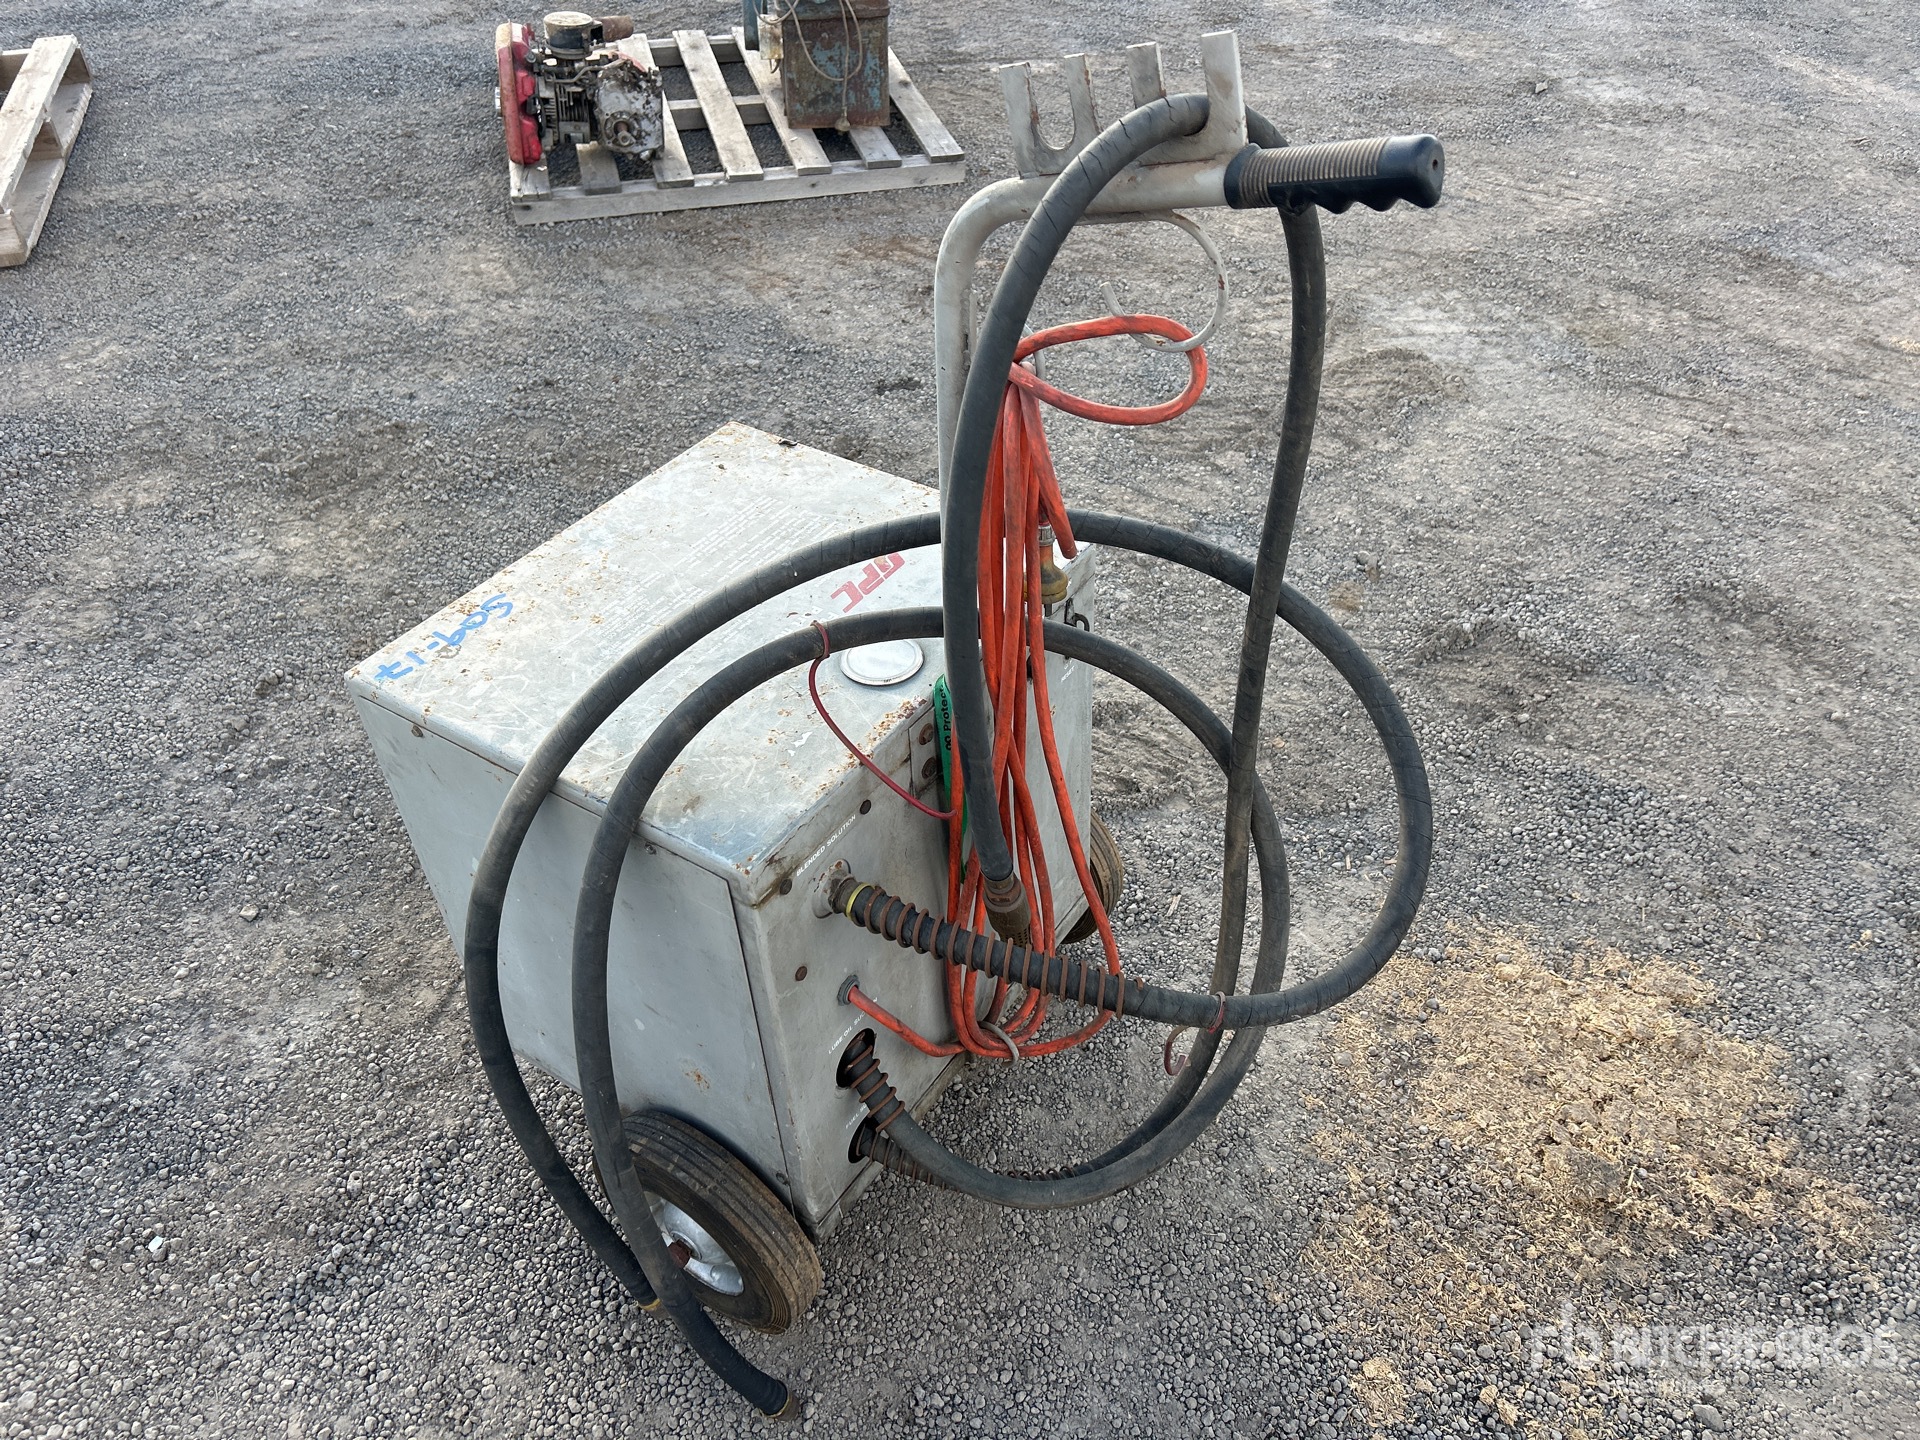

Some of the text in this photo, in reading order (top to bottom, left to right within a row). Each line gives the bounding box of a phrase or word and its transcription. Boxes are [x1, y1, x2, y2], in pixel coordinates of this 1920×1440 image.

[796, 814, 856, 877] BLENDED SOLUTION
[828, 1036, 844, 1055] LUBE
[843, 1024, 854, 1037] OIL
